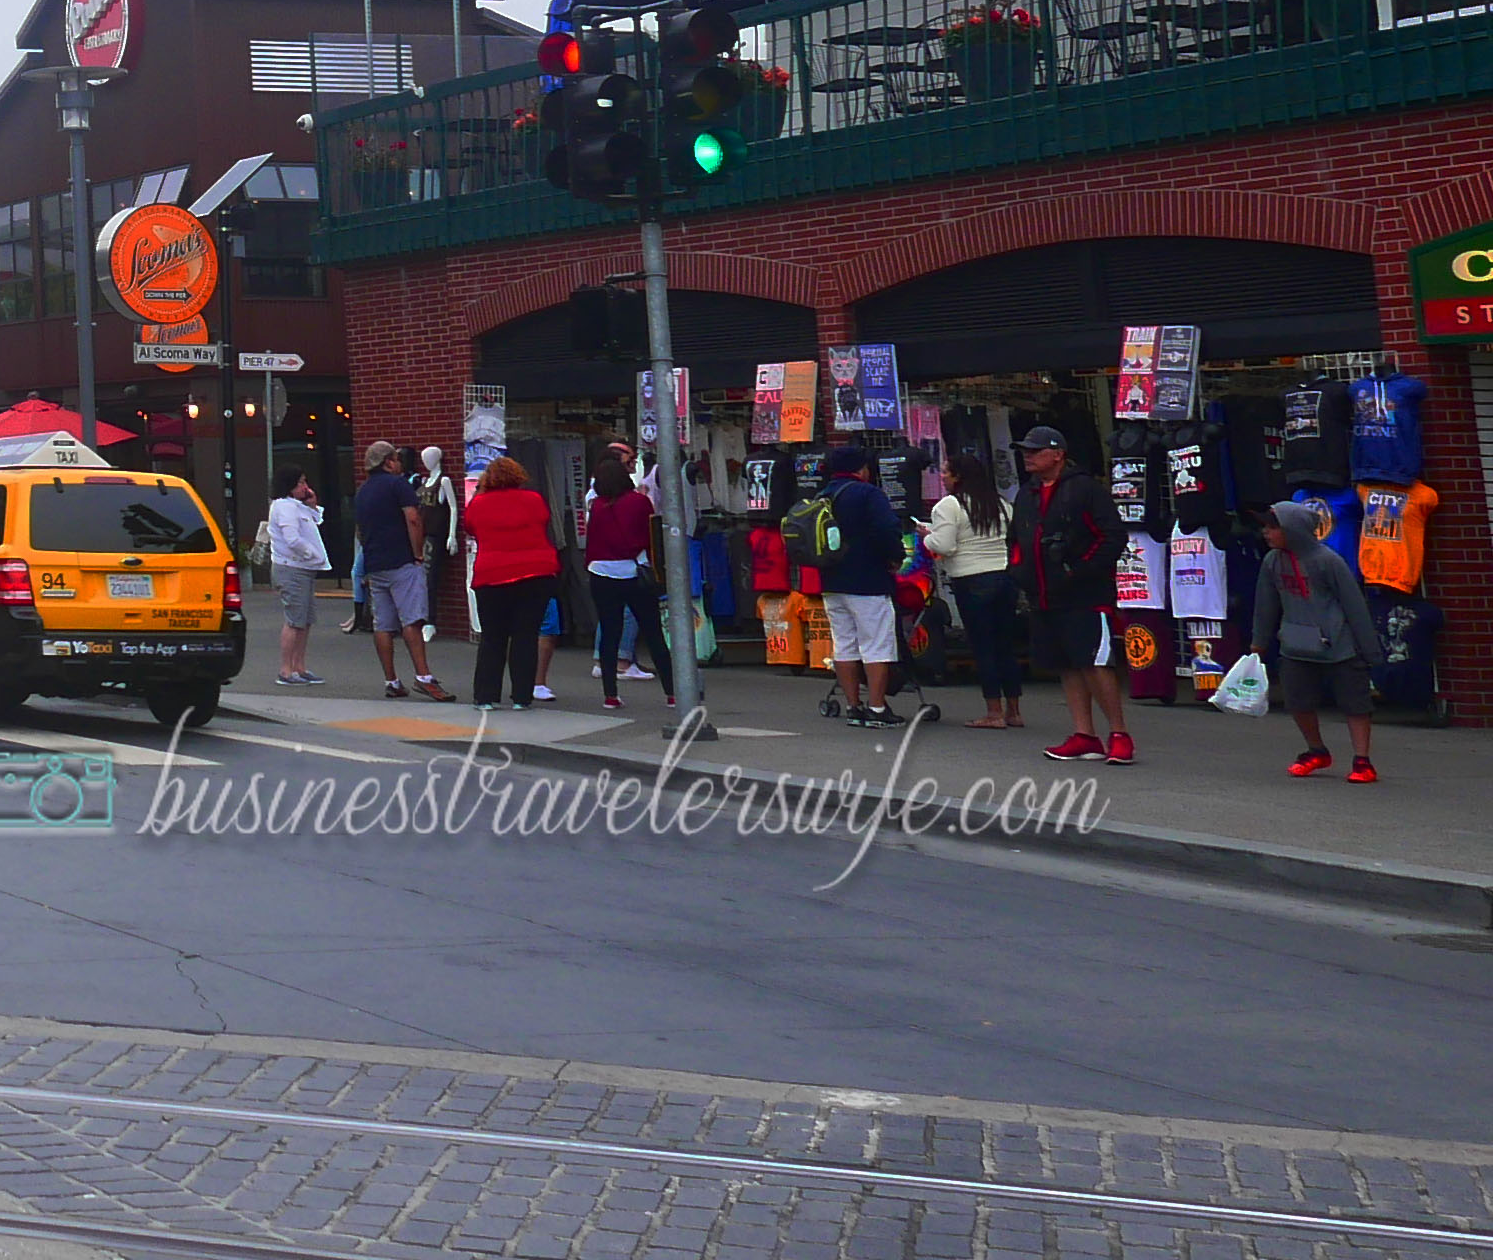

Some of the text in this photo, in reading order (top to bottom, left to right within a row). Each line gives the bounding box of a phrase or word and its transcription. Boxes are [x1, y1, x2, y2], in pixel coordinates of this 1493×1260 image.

[138, 347, 216, 361] Al Scoma Way
[243, 356, 275, 367] PIER 47
[55, 451, 79, 464] TAXI
[1368, 493, 1404, 508] CITY
[41, 572, 66, 590] 94
[151, 609, 214, 619] SAN FRANCISCO
[168, 618, 201, 629] TAXICAB
[72, 640, 113, 654] YoTaxi
[119, 641, 138, 655] Tap
[139, 641, 154, 653] the
[155, 641, 177, 655] App
